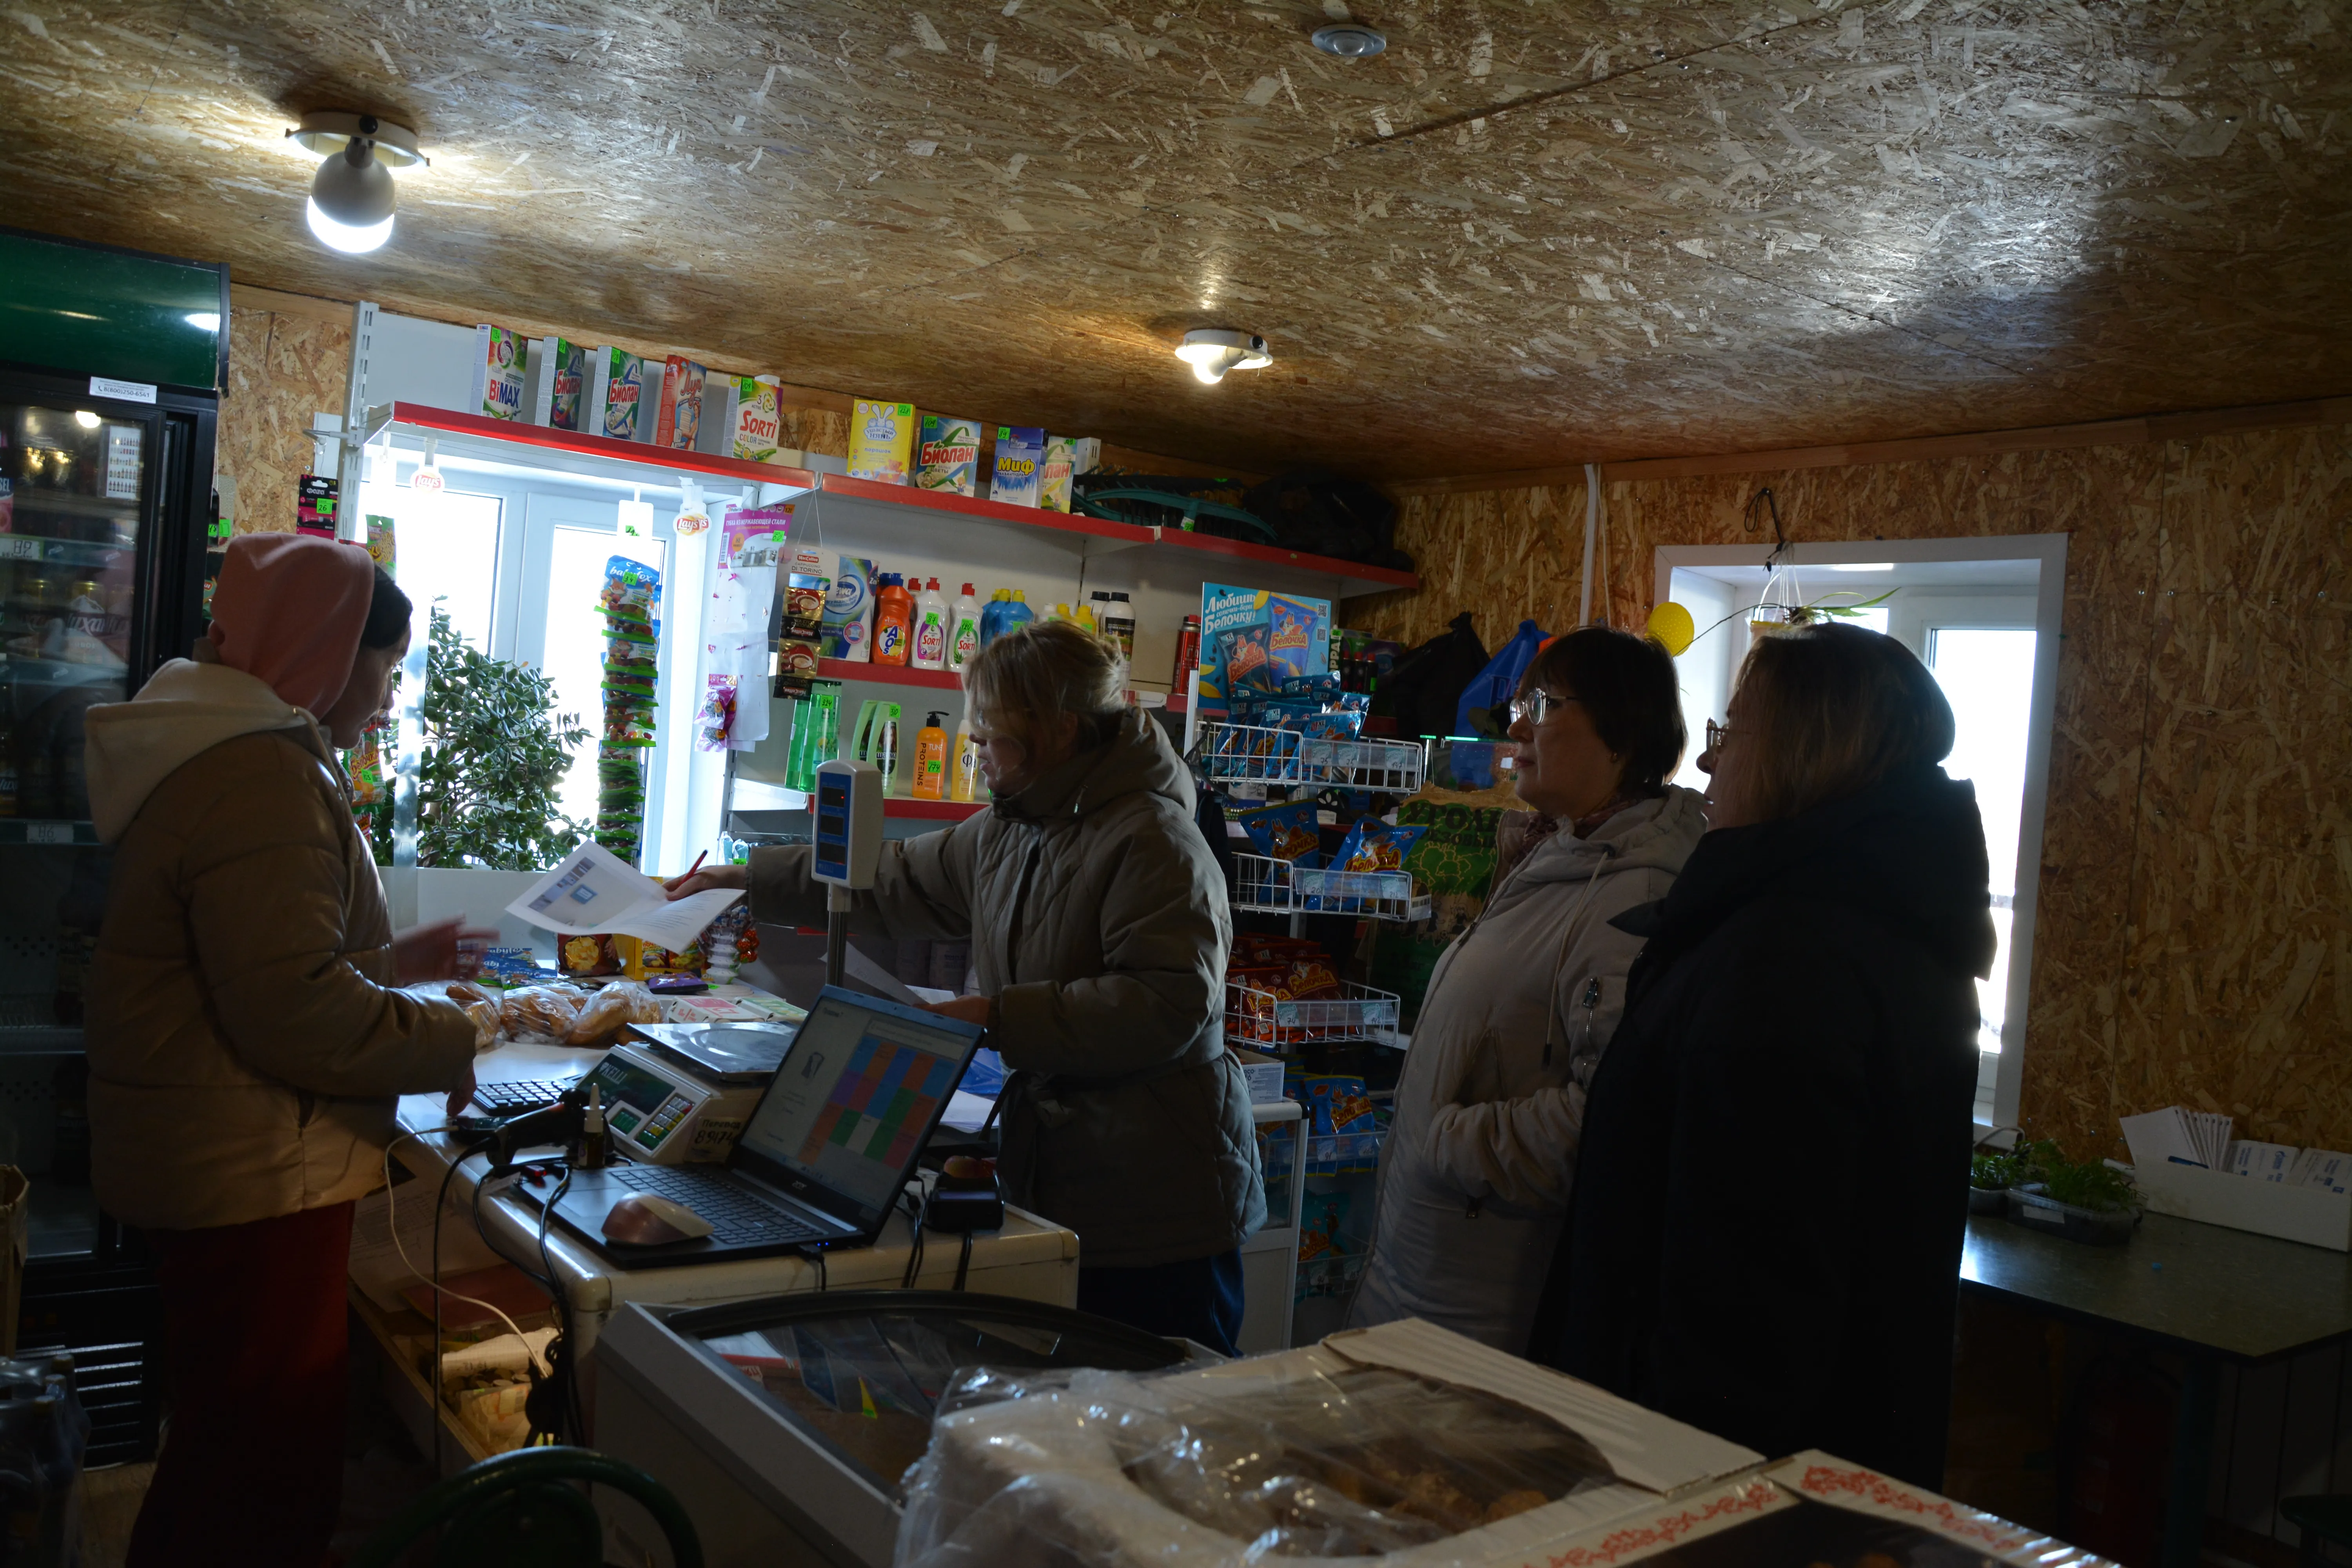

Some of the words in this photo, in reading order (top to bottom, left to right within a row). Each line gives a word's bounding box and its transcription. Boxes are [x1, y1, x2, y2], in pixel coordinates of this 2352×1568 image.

[103, 386, 149, 397] 8(800)250-6541
[555, 370, 581, 394] Биолан
[610, 379, 640, 403] Биолан
[489, 379, 520, 408] BiMAX
[757, 395, 762, 404] 3
[739, 434, 757, 444] COLOR
[921, 443, 974, 464] Биолан
[997, 457, 1035, 475] Миф
[1045, 463, 1070, 479] лан
[1205, 593, 1256, 614] Любишь
[1205, 610, 1256, 635] Белочку!
[917, 742, 926, 786] PROTEINS
[928, 764, 940, 772] 174
[601, 1063, 628, 1085] KELLI
[702, 1120, 741, 1130] Перевод
